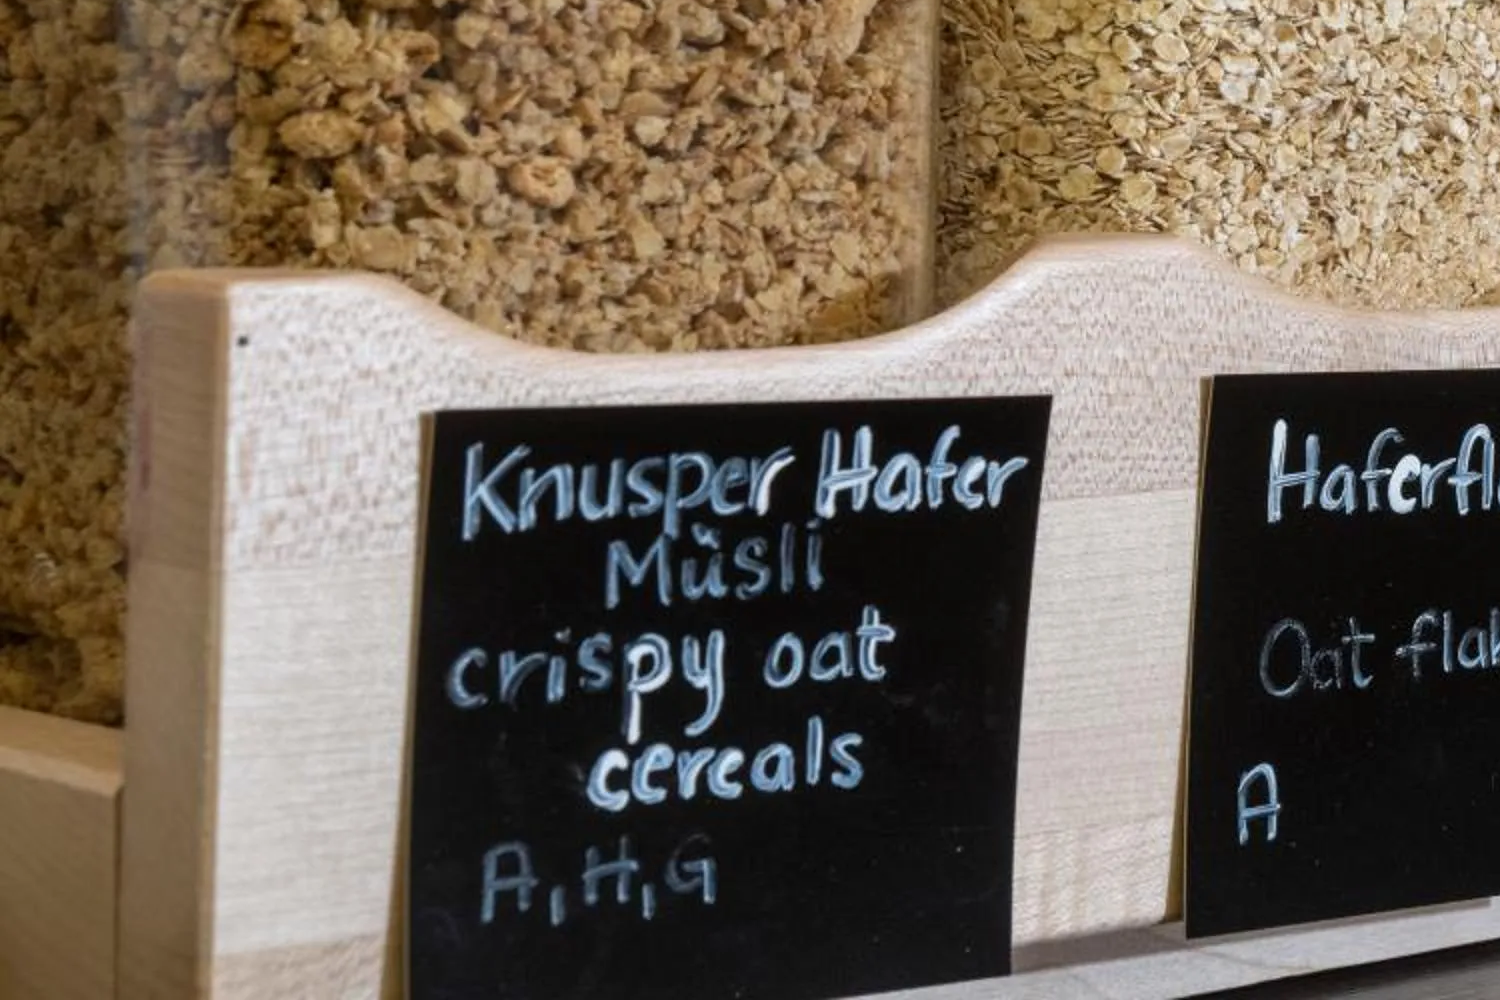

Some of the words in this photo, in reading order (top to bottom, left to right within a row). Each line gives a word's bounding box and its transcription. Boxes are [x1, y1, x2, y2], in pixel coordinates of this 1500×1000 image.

[461, 442, 796, 547] Knusper
[814, 424, 1030, 520] Hafer
[605, 516, 824, 610] Müsli
[446, 626, 727, 744] crispy
[763, 605, 897, 689] oat
[1258, 616, 1377, 699] Oat
[585, 714, 866, 812] cereals
[1236, 761, 1282, 845] A
